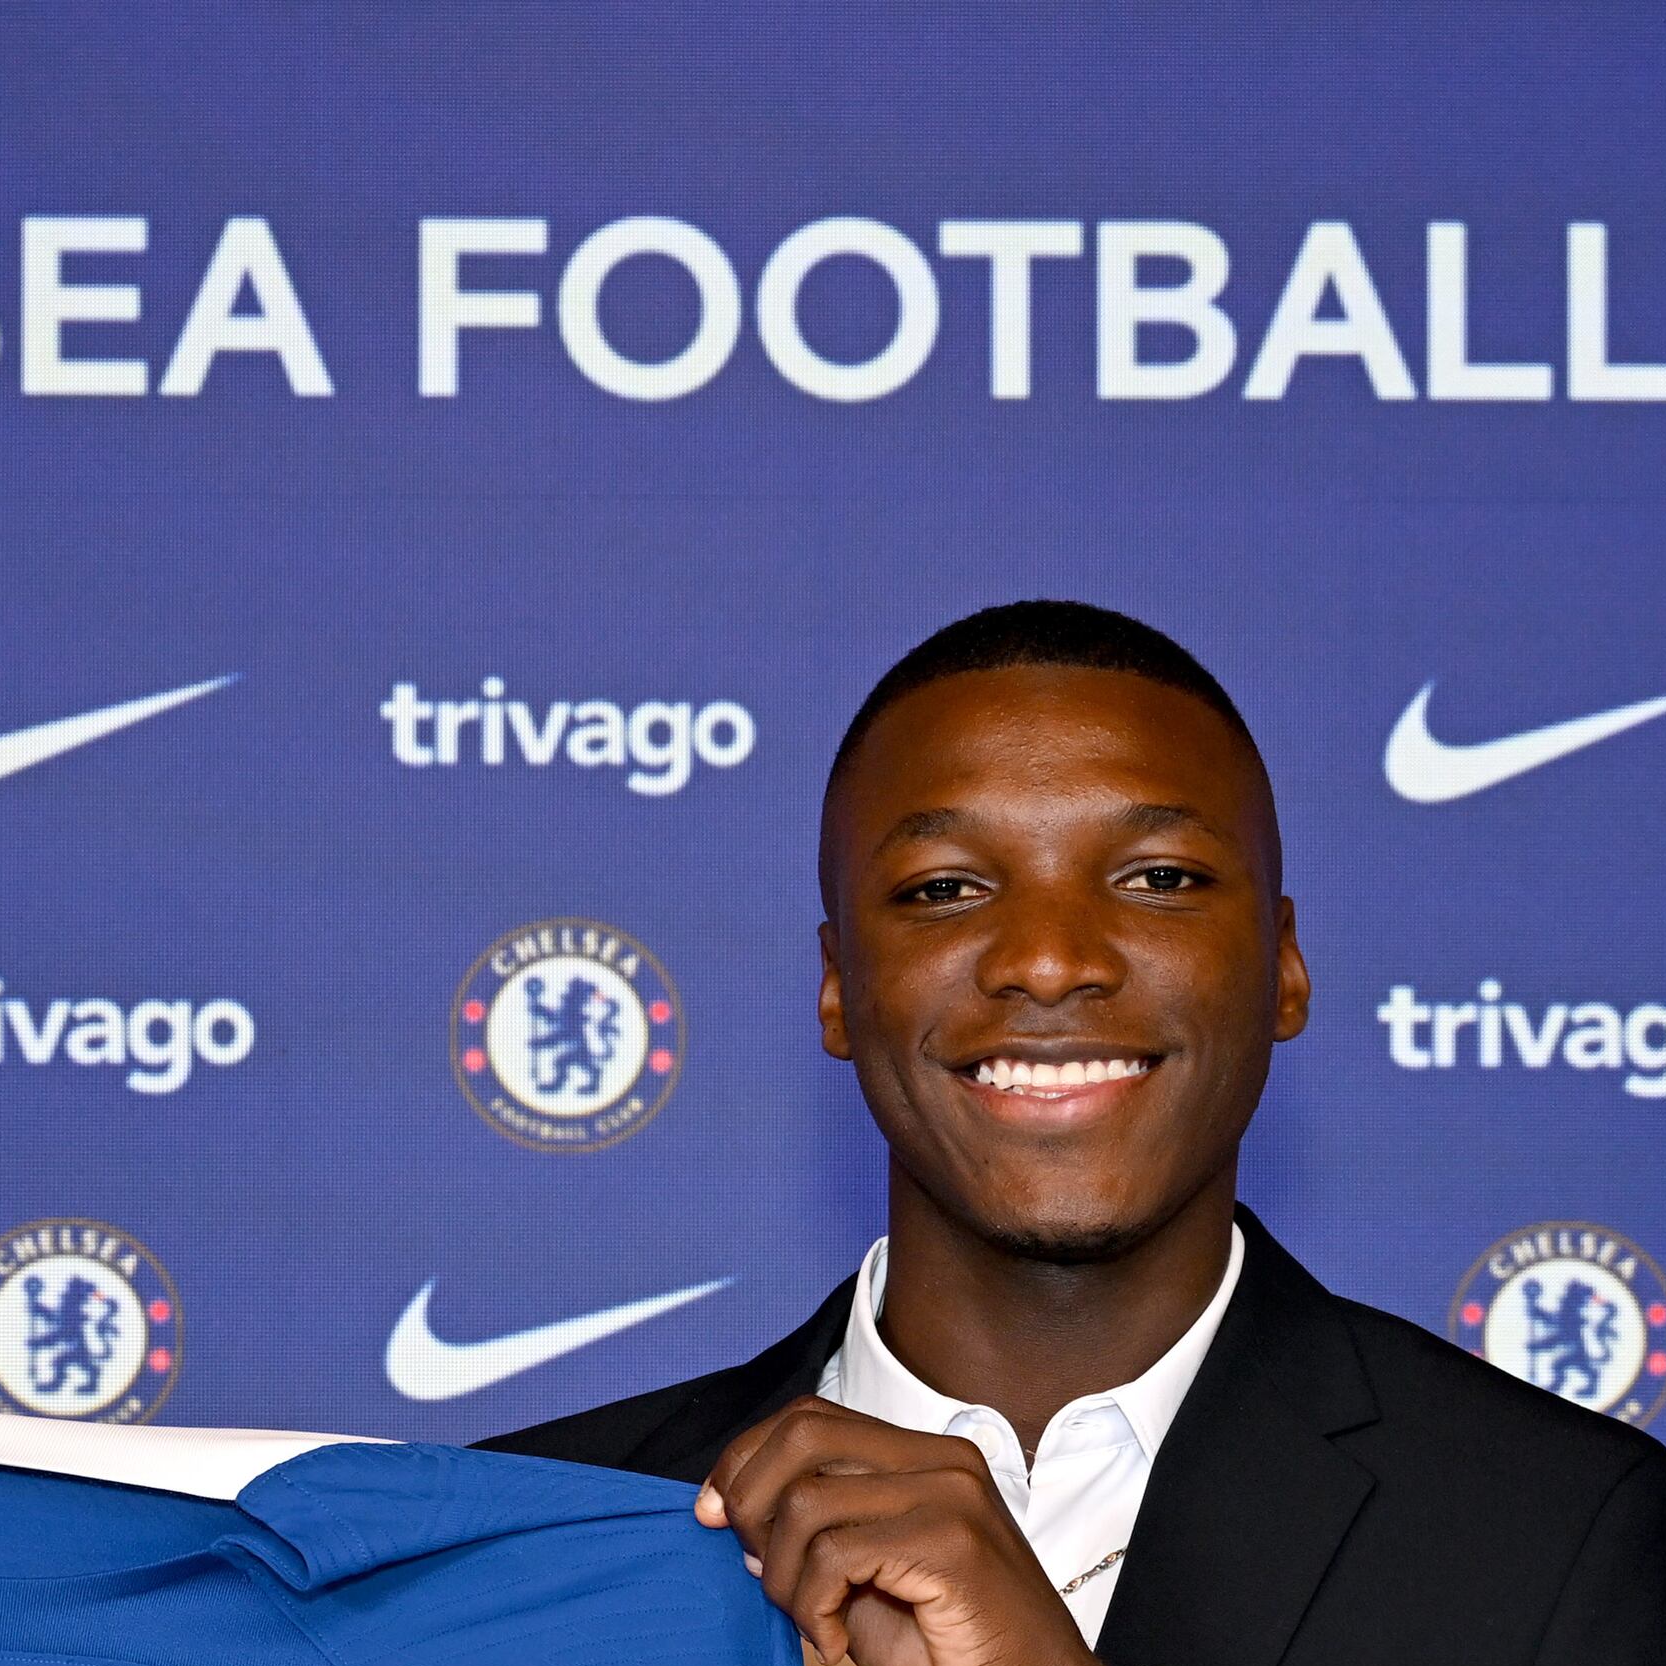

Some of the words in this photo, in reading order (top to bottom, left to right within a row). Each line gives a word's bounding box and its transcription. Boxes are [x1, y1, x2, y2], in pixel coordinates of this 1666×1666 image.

[381, 677, 755, 796] trivago
[489, 925, 641, 977] CHELSEA
[1488, 1229, 1638, 1280] CHELSEA
